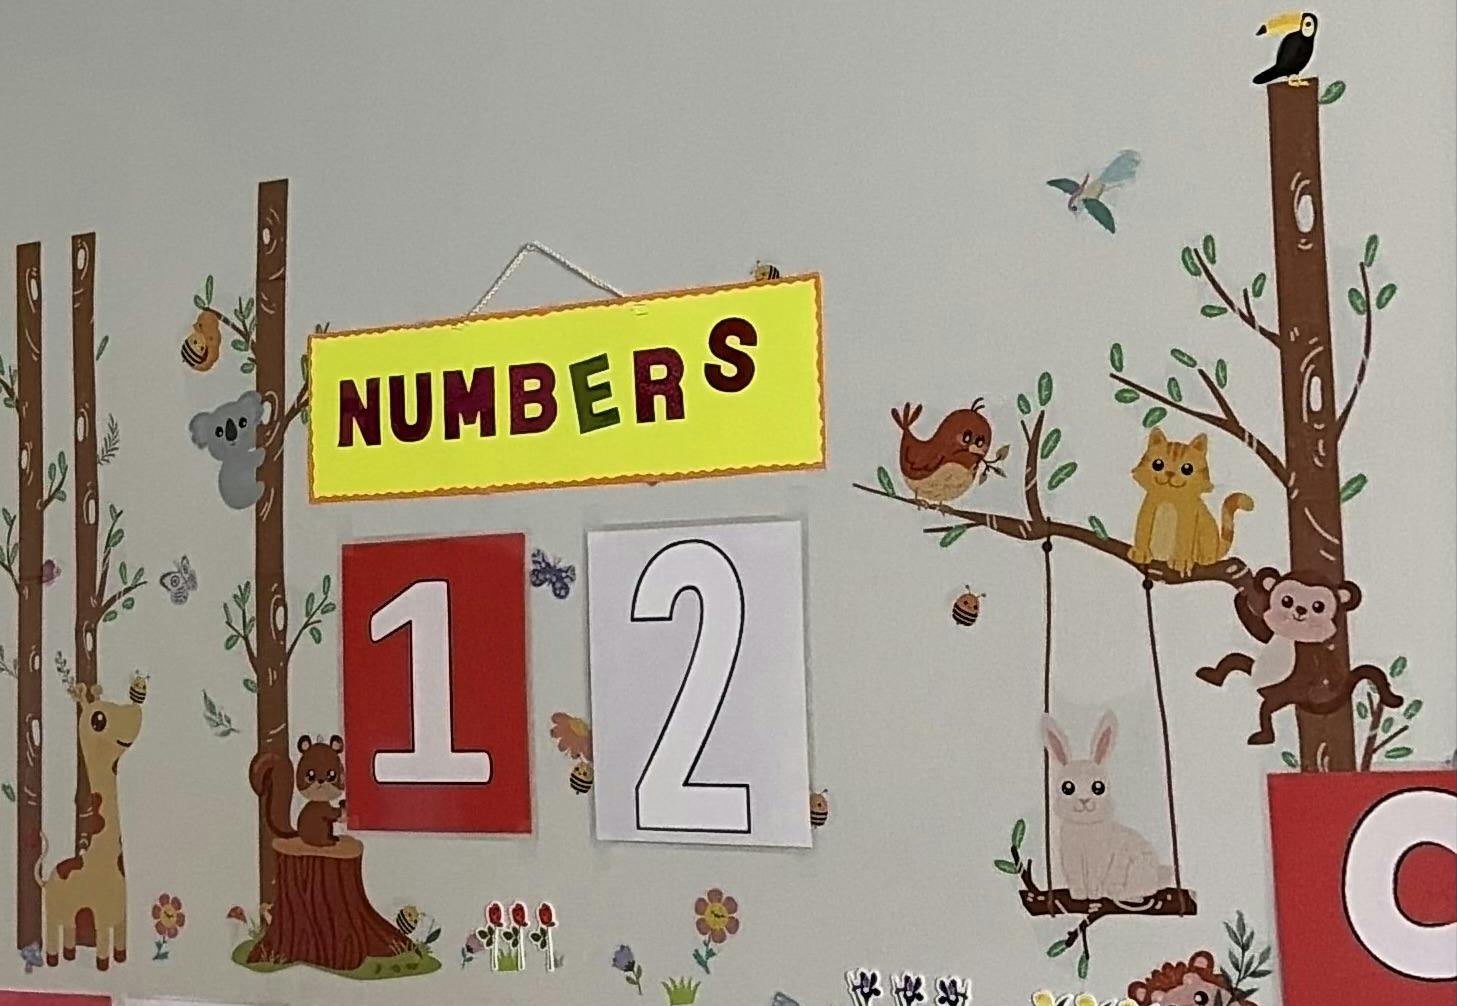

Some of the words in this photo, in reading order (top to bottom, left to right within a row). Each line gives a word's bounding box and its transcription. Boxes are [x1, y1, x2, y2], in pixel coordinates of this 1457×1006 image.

[337, 317, 758, 448] NUMBERS
[369, 579, 493, 786] 1
[630, 538, 751, 835] 2
